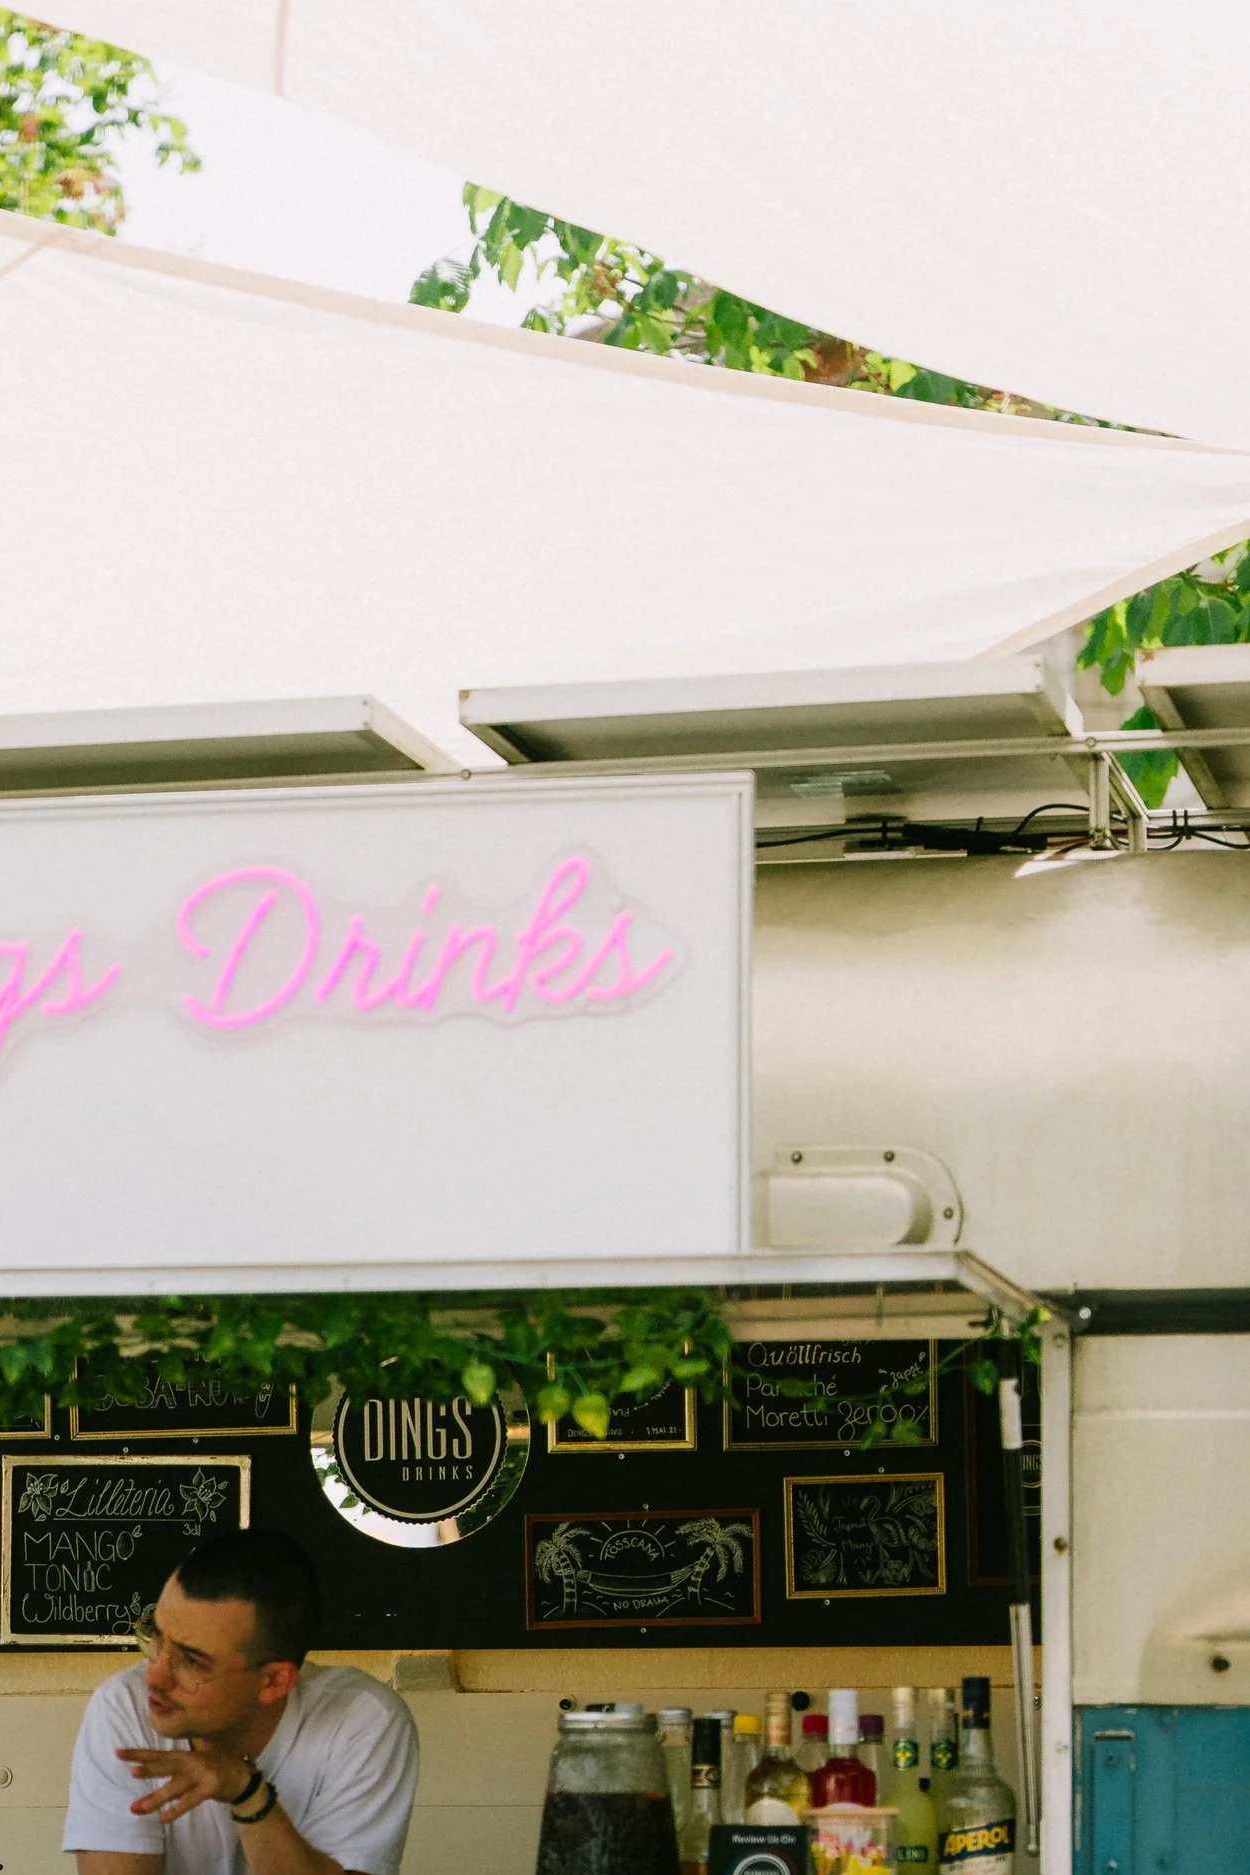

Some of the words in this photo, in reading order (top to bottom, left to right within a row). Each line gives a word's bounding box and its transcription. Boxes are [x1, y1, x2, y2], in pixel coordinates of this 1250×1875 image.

[175, 857, 674, 1028] Drinks
[747, 1342, 862, 1367] Quöllfrisch
[363, 1396, 473, 1462] DINGS
[402, 1465, 473, 1482] DRINKS
[24, 1530, 135, 1562] MANGO
[22, 1593, 133, 1634] Wildberry
[613, 1600, 630, 1611] NO
[732, 1833, 766, 1844] Review
[944, 1826, 1010, 1857] APEROL
